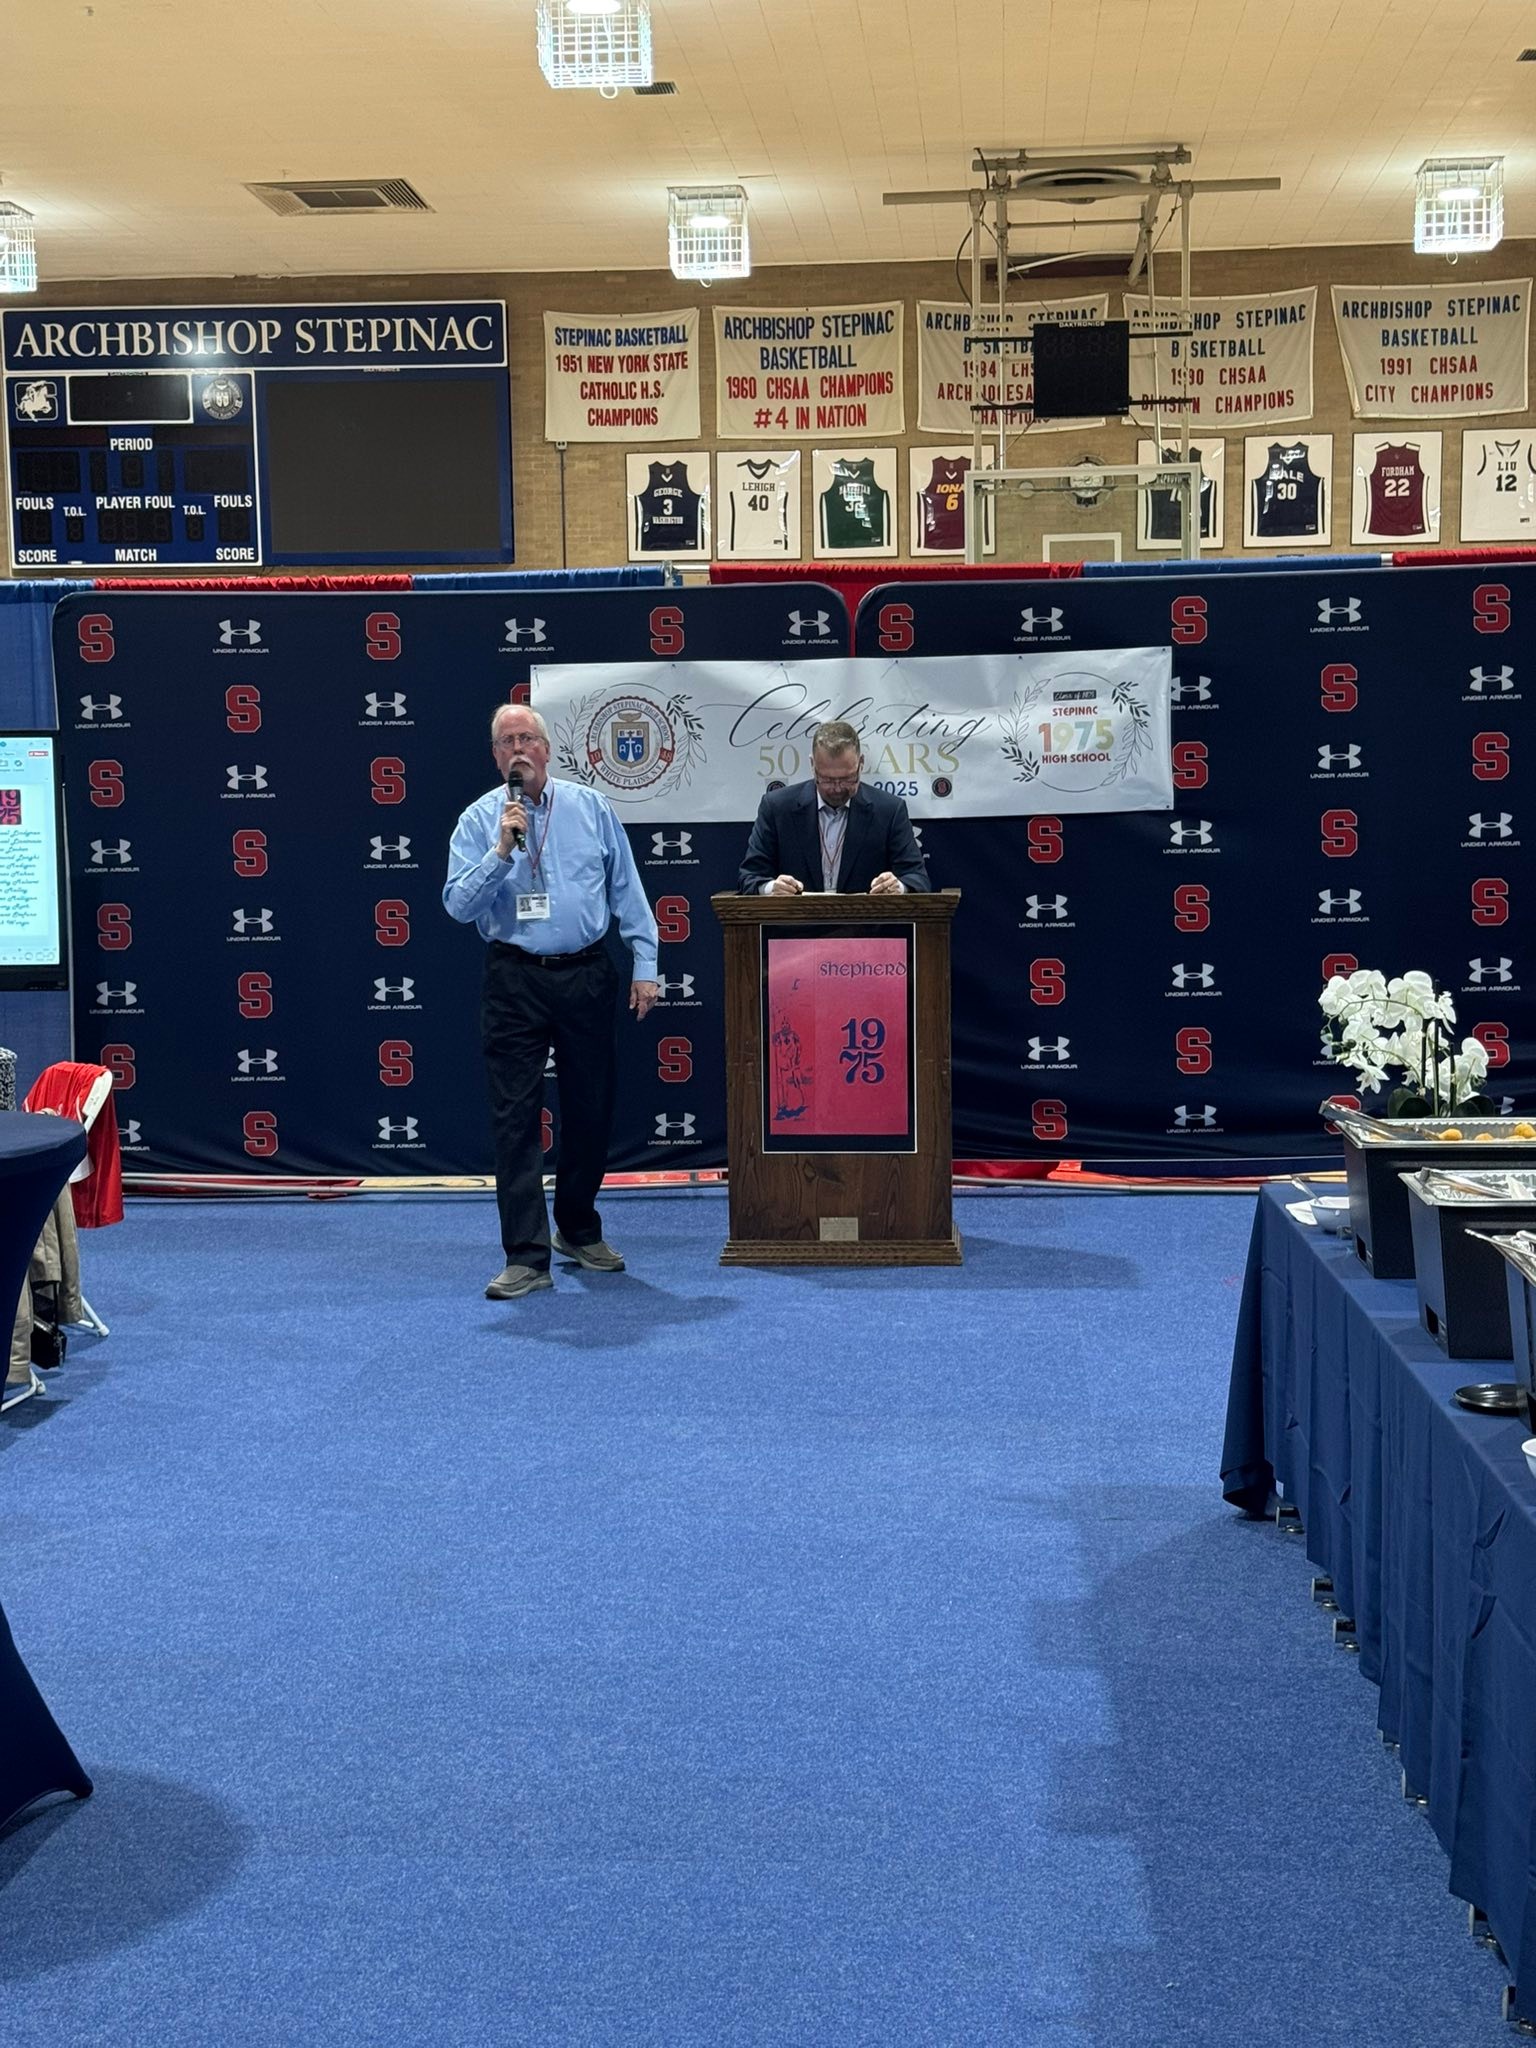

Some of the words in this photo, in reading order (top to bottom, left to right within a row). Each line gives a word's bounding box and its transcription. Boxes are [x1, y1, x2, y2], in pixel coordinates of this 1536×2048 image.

[1236, 304, 1307, 329] STEPINAC
[1342, 300, 1432, 319] ARCHBISHOP
[1447, 294, 1521, 317] STEPINAC
[13, 318, 282, 358] ARCHBISHOP
[295, 315, 494, 356] STEPINAC
[555, 326, 612, 347] STEPINAC
[615, 325, 688, 347] BASKETBALL
[724, 316, 815, 340] ARCHBISHOP
[822, 310, 895, 338] STEPINAC
[1381, 326, 1479, 347] BASKETBALL
[760, 344, 857, 370] BASKETBALL
[1171, 338, 1266, 358] BSKETBALL
[556, 354, 583, 373] 1951
[587, 355, 614, 373] NEW
[618, 354, 650, 373] YORK
[653, 351, 688, 371] STATE
[1380, 357, 1412, 376] 1991
[1430, 355, 1478, 375] CHSAA
[726, 376, 757, 400] 1960
[766, 376, 810, 400] CHSAA
[820, 371, 893, 399] CHAMPIONS
[1219, 365, 1267, 385] CHSAA
[580, 381, 637, 400] CATHOLIC
[641, 380, 664, 399] H.S.
[1215, 389, 1295, 414] CHAMPIONS
[1365, 384, 1396, 403] CITY
[1411, 382, 1494, 403] CHAMPIONS
[588, 407, 659, 427] CHAMPIONS
[796, 407, 810, 429] IN
[817, 403, 867, 429] NATION
[110, 437, 153, 451] PERIOD
[1381, 465, 1416, 477] FORDHAM
[1497, 462, 1517, 472] LIU
[654, 487, 683, 498] GEORGE
[742, 482, 776, 492] LEHIGH
[1277, 483, 1297, 500] 30
[1384, 478, 1410, 498] 22
[1496, 474, 1518, 492] 12
[15, 497, 54, 510] FOULS
[63, 506, 87, 517] T.O.L.
[96, 496, 141, 510] PLAYER
[145, 496, 176, 509] FOUL
[183, 505, 207, 516] T.O.L.
[214, 495, 253, 508] FOULS
[663, 499, 673, 516] 3
[747, 495, 769, 512] 40
[946, 494, 959, 511] 6
[18, 549, 57, 563] SCORE
[115, 549, 158, 562] MATCH
[216, 547, 255, 561] SCORE
[1171, 596, 1207, 644] S
[1473, 584, 1510, 633] S
[78, 614, 115, 662] S
[366, 612, 401, 660] S
[650, 607, 684, 655] S
[879, 603, 914, 651] S
[1310, 625, 1335, 633] UNDER
[1337, 625, 1369, 633] ARMOUR
[1321, 663, 1358, 712] S
[1462, 693, 1487, 701] UNDER
[1489, 693, 1521, 701] ARMOUR
[225, 685, 261, 733] S
[1052, 706, 1098, 716] STEPINAC
[1038, 719, 1114, 753] 1975
[757, 744, 799, 777] 50
[861, 742, 960, 774] EARS
[1042, 754, 1067, 764] HIGH
[1071, 753, 1111, 763] SCHOOL
[1473, 732, 1509, 780] S
[89, 760, 124, 807] S
[371, 757, 406, 804] S
[600, 764, 621, 783] WHITE
[874, 781, 918, 797] 2025
[1028, 817, 1063, 863] S
[1321, 809, 1358, 857] S
[233, 830, 268, 877] S
[1174, 885, 1210, 932] S
[1472, 878, 1508, 926] S
[98, 904, 132, 950] S
[375, 900, 410, 946] S
[1030, 958, 1065, 1005] S
[238, 972, 272, 1018] S
[840, 1017, 886, 1050] 19
[658, 1037, 692, 1082] S
[1176, 1027, 1212, 1074] S
[839, 1050, 886, 1084] 75
